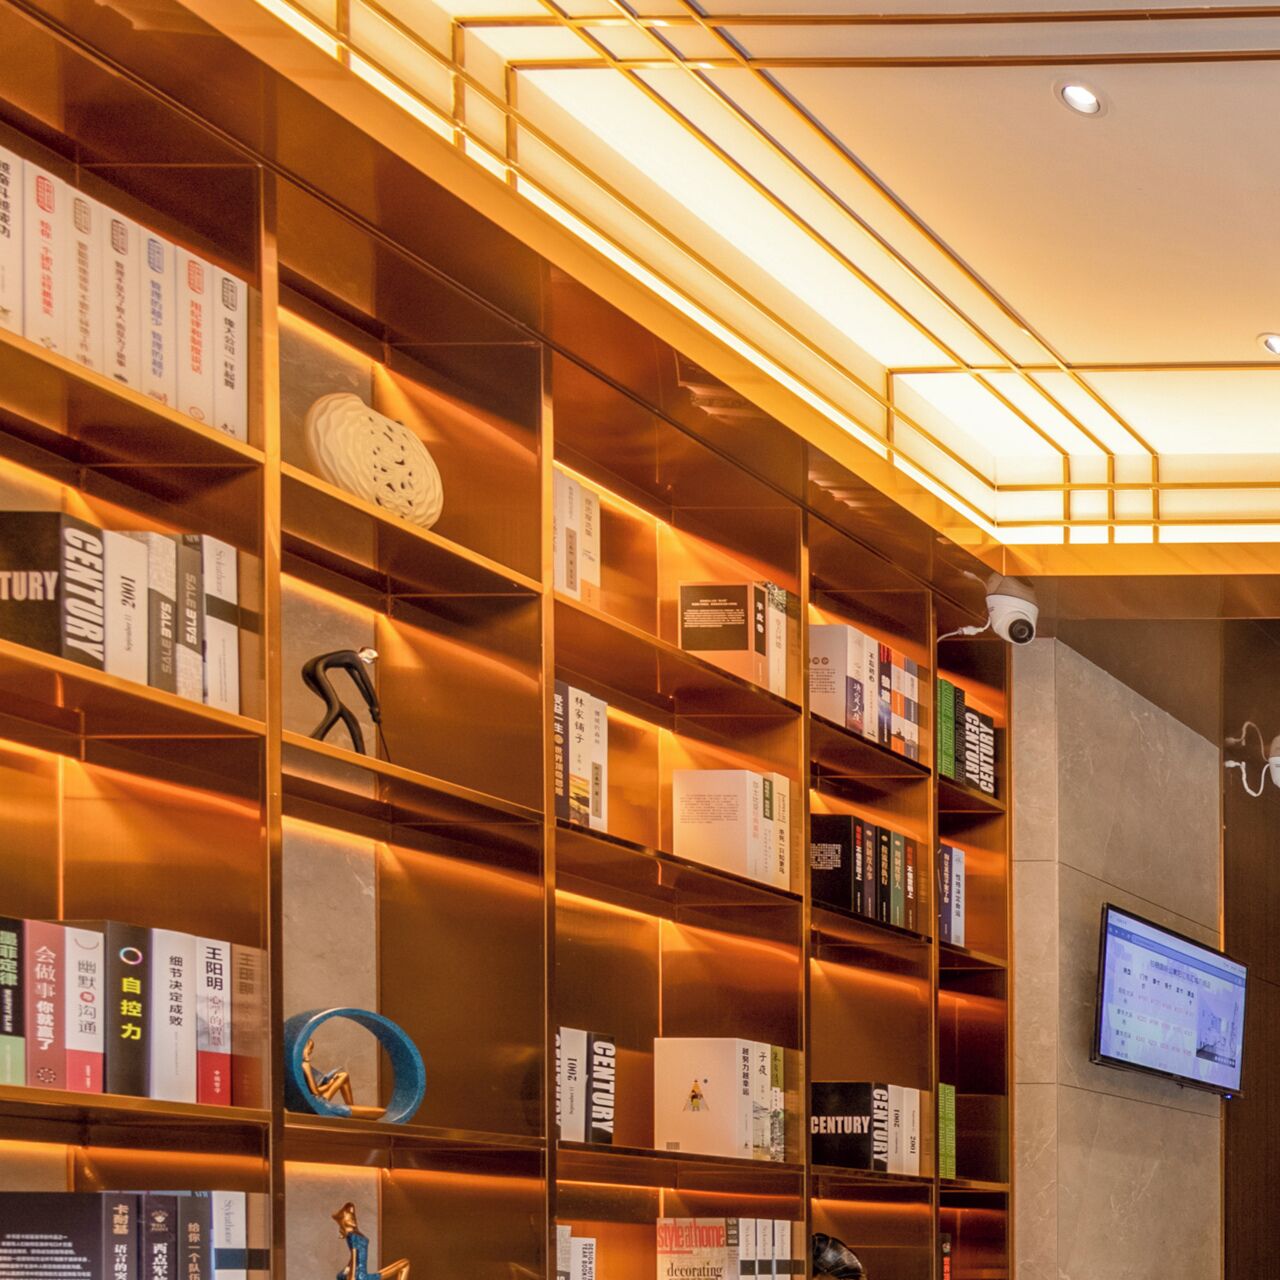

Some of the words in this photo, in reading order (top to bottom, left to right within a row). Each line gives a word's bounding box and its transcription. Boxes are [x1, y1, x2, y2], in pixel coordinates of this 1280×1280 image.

[63, 527, 104, 662] CENTURY
[120, 575, 136, 609] 2001
[160, 602, 172, 639] SALE
[575, 696, 585, 744] 林家铺子
[965, 711, 980, 785] CENTURY
[980, 722, 994, 794] CENTURY
[169, 955, 183, 1027] 细节决定成败
[205, 946, 223, 992] 王阳明
[121, 977, 142, 1040] 自控力
[567, 1058, 577, 1081] 2001
[592, 1041, 616, 1134] CENTURY
[811, 1116, 870, 1135] CENTURY
[873, 1088, 888, 1163] CENTURY
[113, 1204, 129, 1235] 卡耐基
[667, 1262, 723, 1279] decorating
